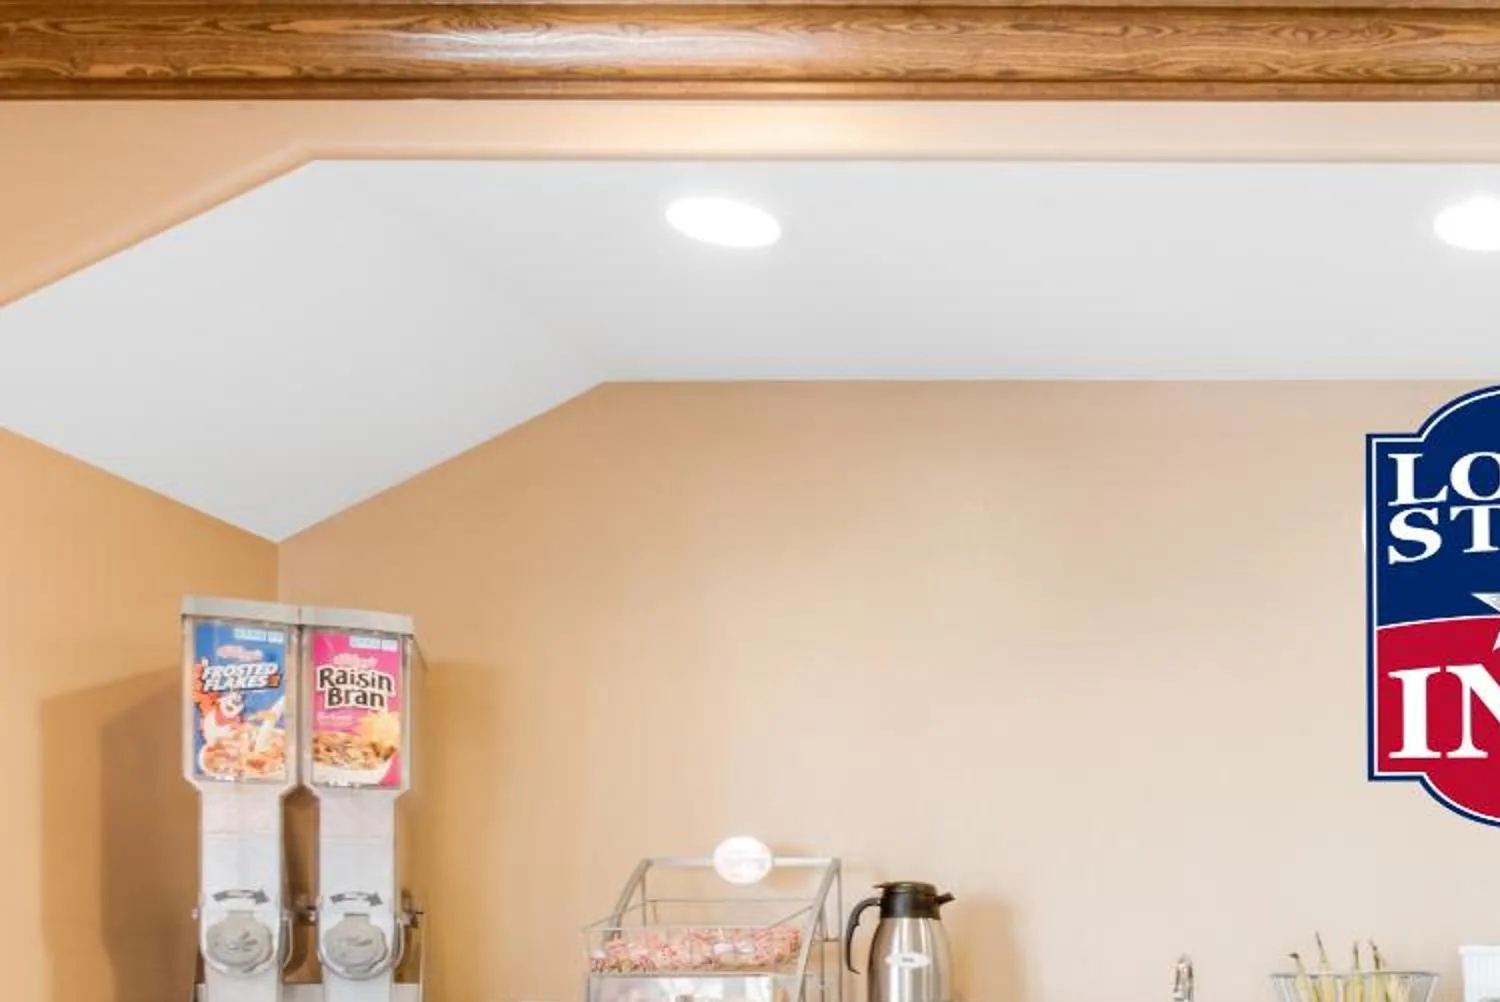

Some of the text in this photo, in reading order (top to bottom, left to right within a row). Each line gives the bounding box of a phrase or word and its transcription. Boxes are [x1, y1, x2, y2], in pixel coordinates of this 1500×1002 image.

[202, 663, 279, 681] FROSTED
[319, 667, 392, 692] Raisin
[203, 675, 267, 692] FLAKES
[327, 687, 385, 707] Bran
